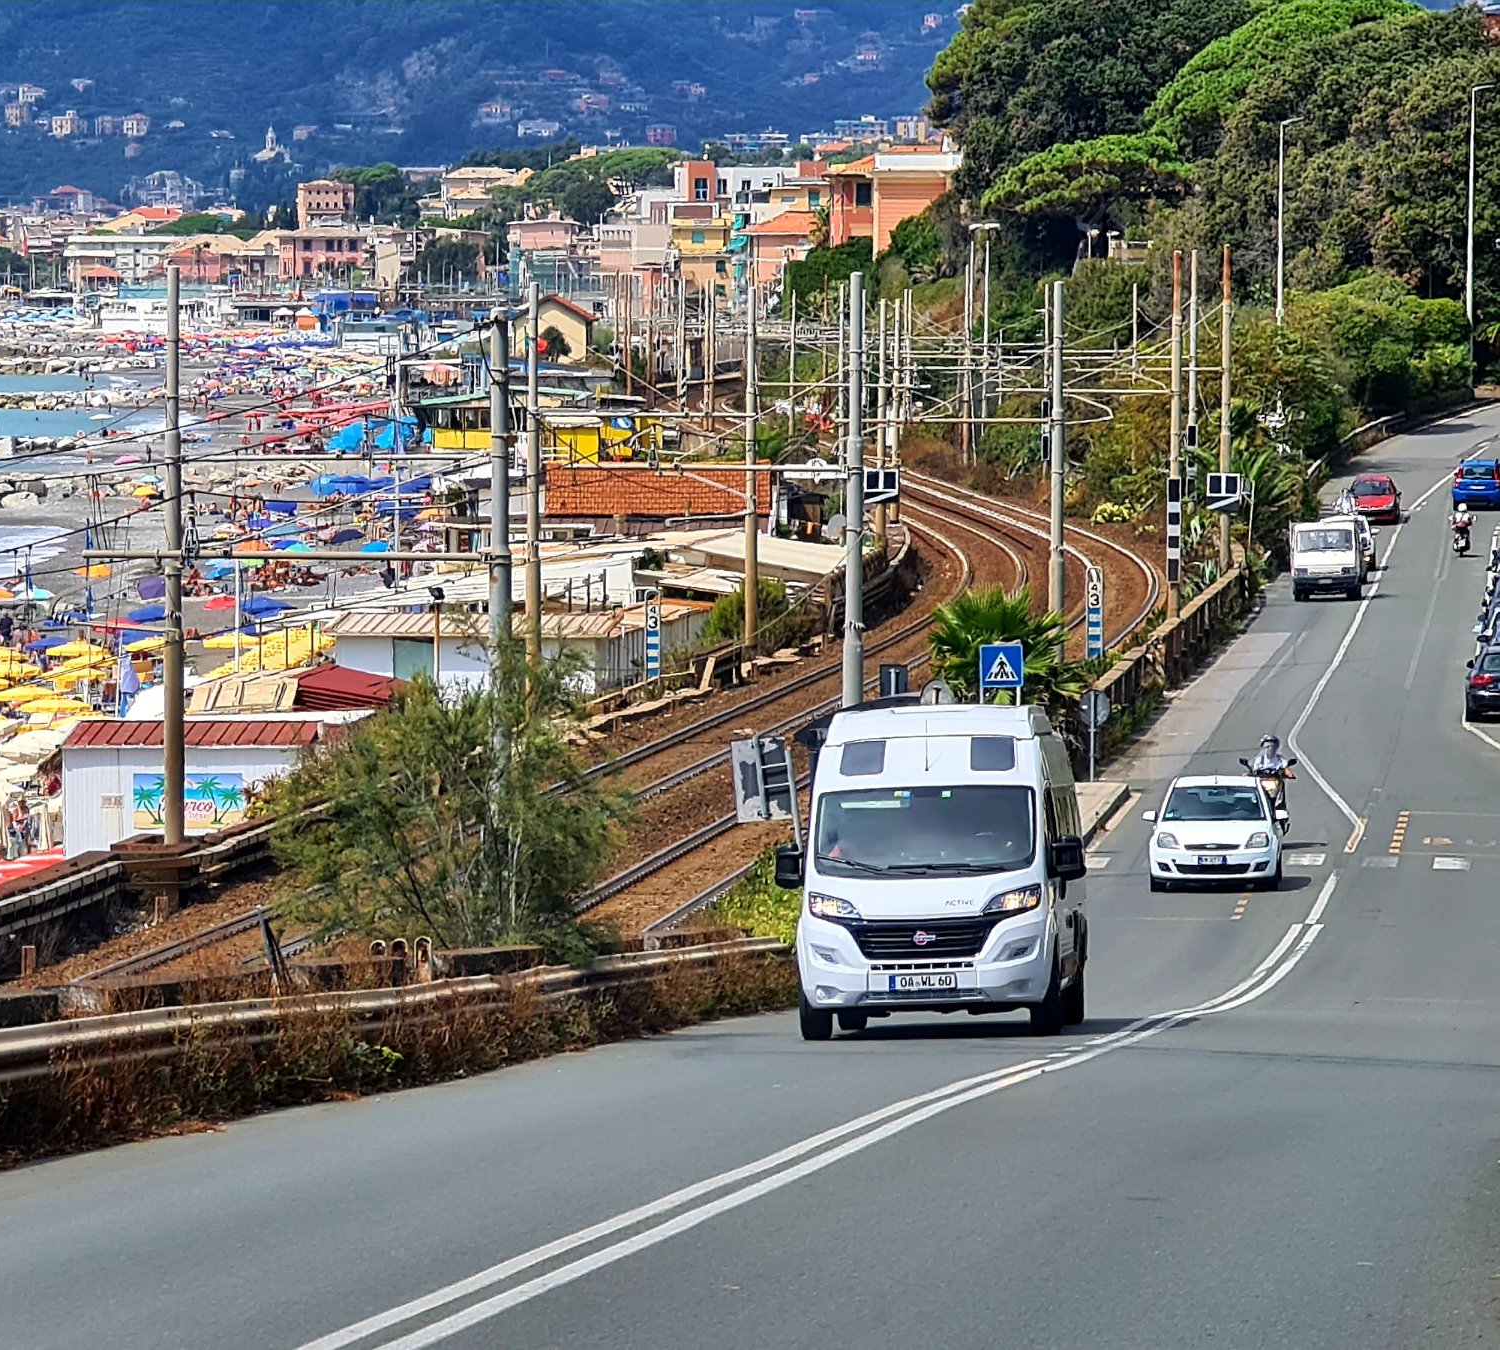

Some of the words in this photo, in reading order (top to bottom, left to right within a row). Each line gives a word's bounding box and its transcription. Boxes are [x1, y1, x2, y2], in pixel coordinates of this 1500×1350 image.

[1090, 593, 1100, 606] 3
[649, 605, 657, 615] 4
[648, 615, 659, 629] 3
[161, 795, 213, 812] rco
[900, 976, 915, 988] OA
[921, 975, 936, 987] WL
